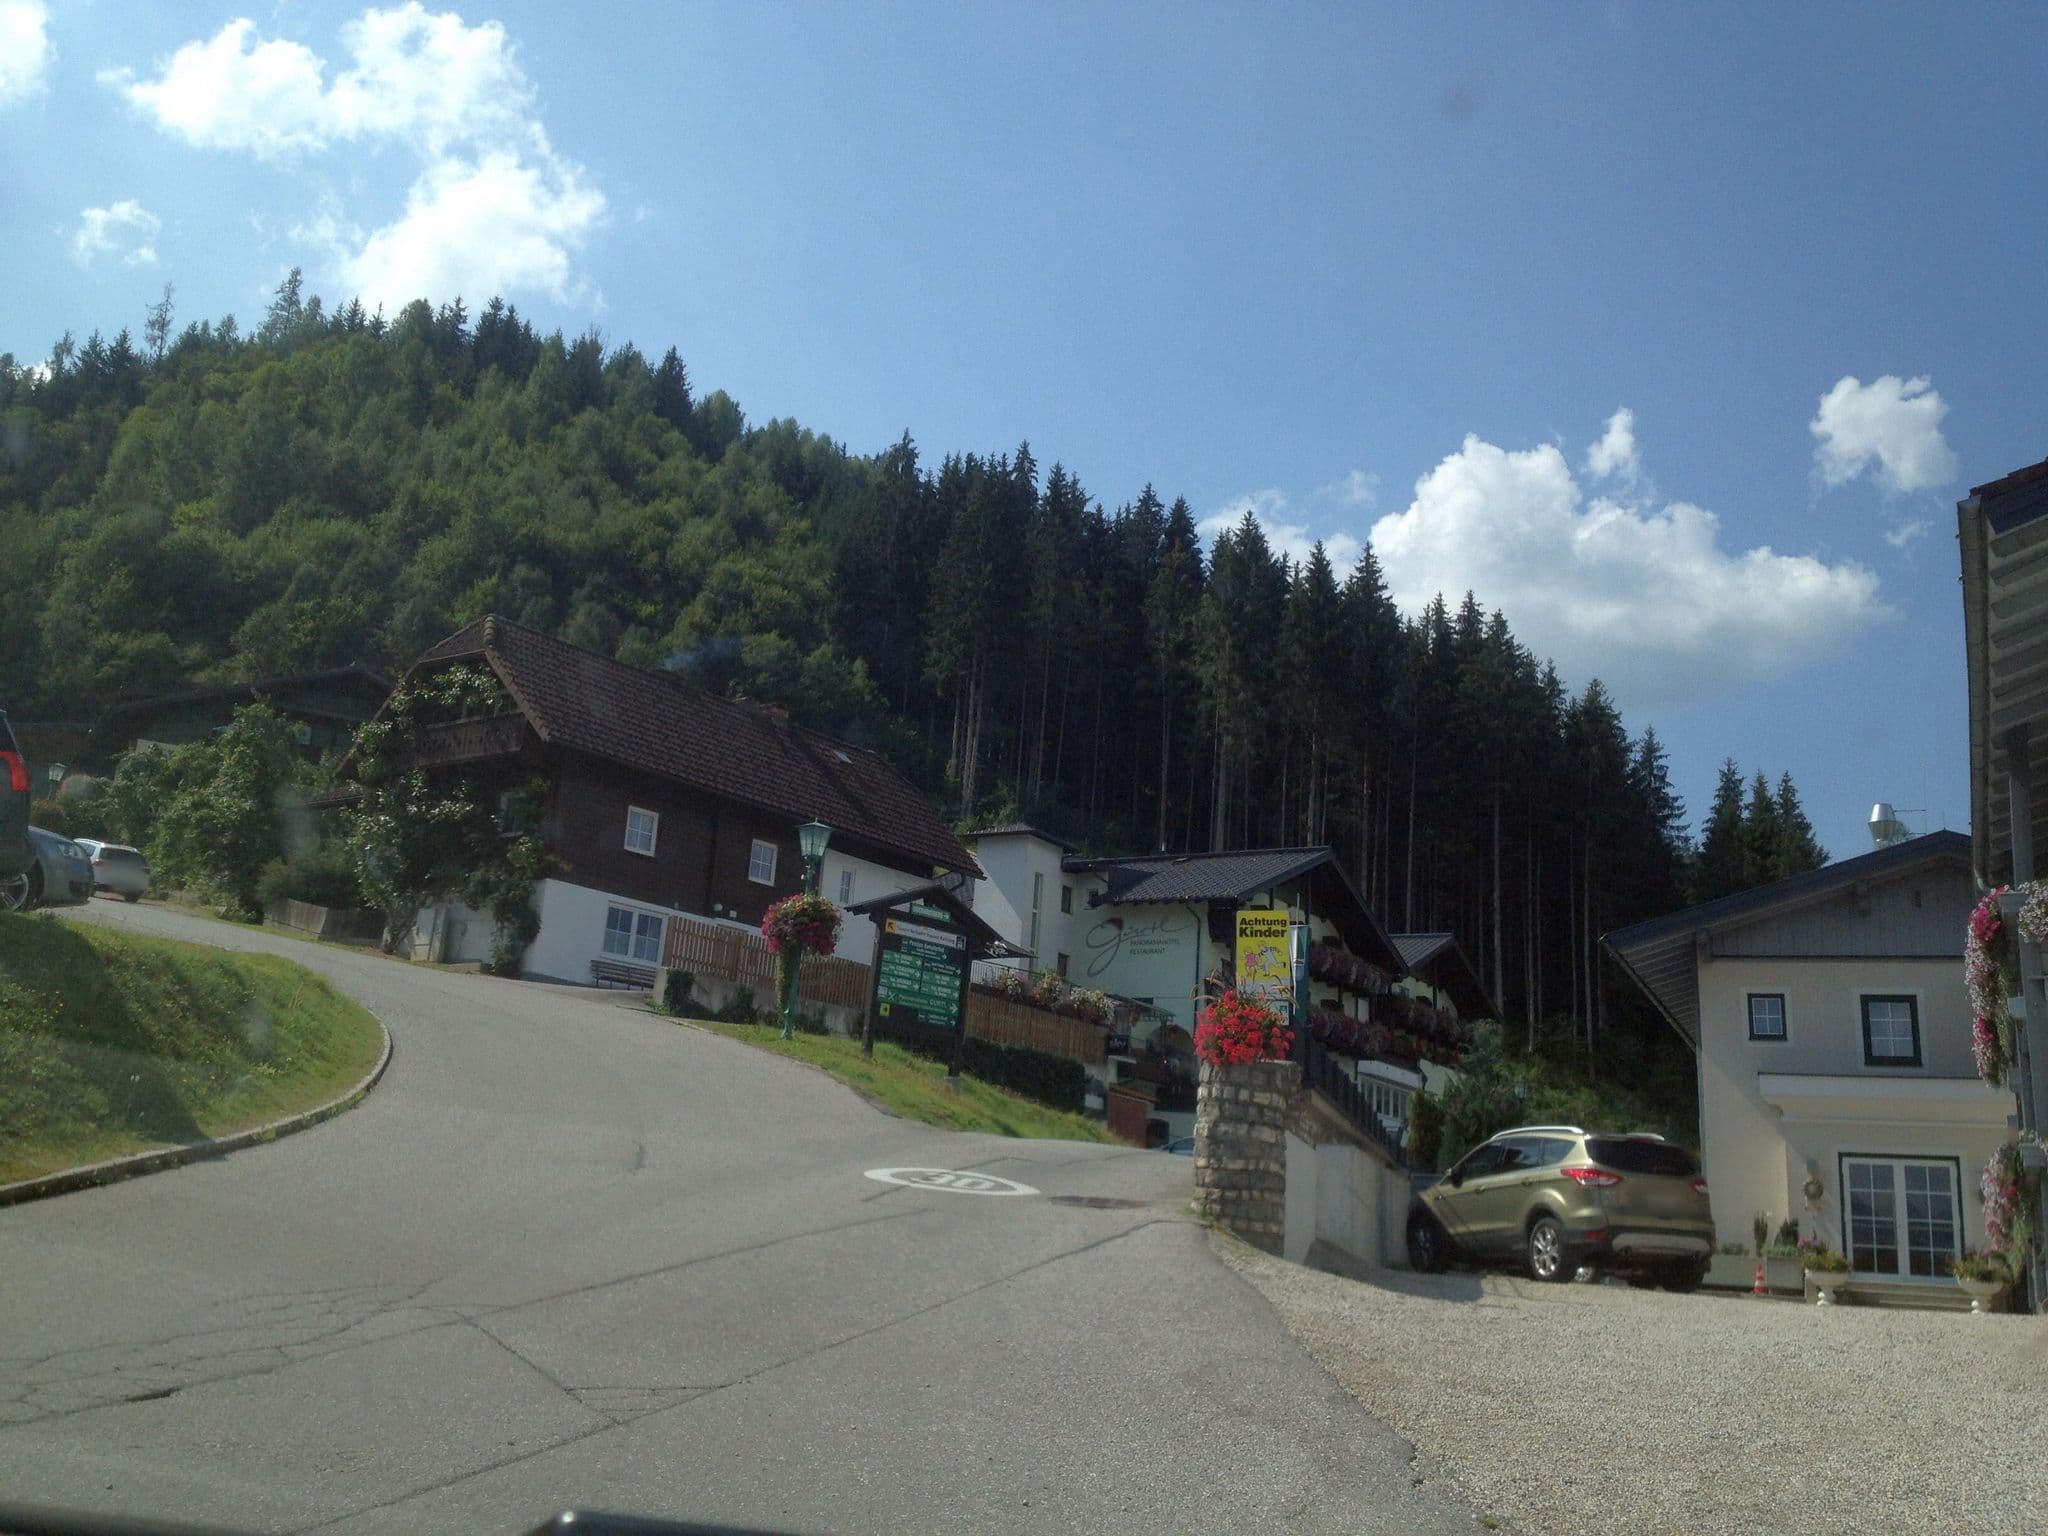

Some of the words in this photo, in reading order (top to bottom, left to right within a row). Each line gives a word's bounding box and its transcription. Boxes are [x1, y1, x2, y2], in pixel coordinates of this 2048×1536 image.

[1240, 917, 1287, 927] Achtung
[1240, 927, 1287, 937] Kinder
[910, 1171, 995, 1189] 30
